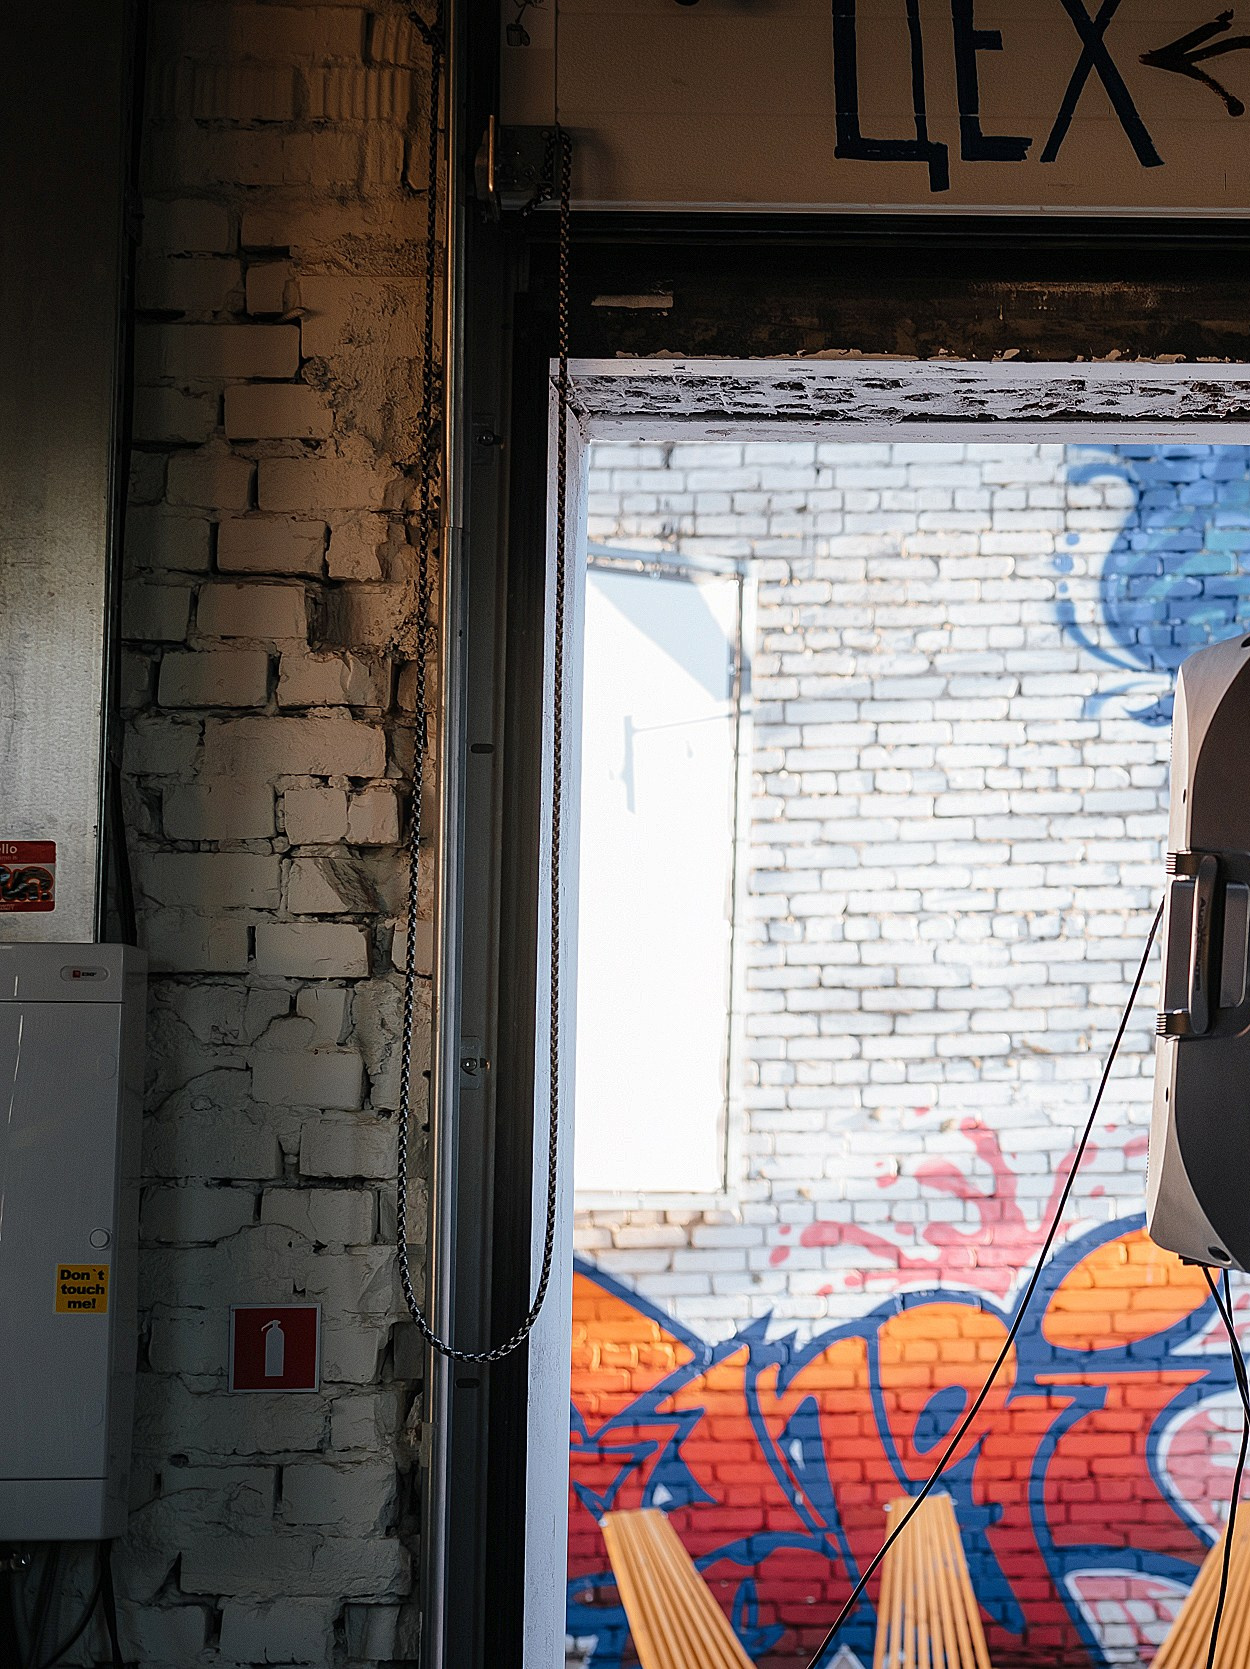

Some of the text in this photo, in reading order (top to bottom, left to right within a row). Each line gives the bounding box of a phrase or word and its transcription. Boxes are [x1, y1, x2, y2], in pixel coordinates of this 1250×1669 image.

[832, 0, 1165, 193] ЦЕХ
[0, 843, 18, 855] llo
[60, 1283, 105, 1295] touch
[67, 1298, 97, 1309] me!
